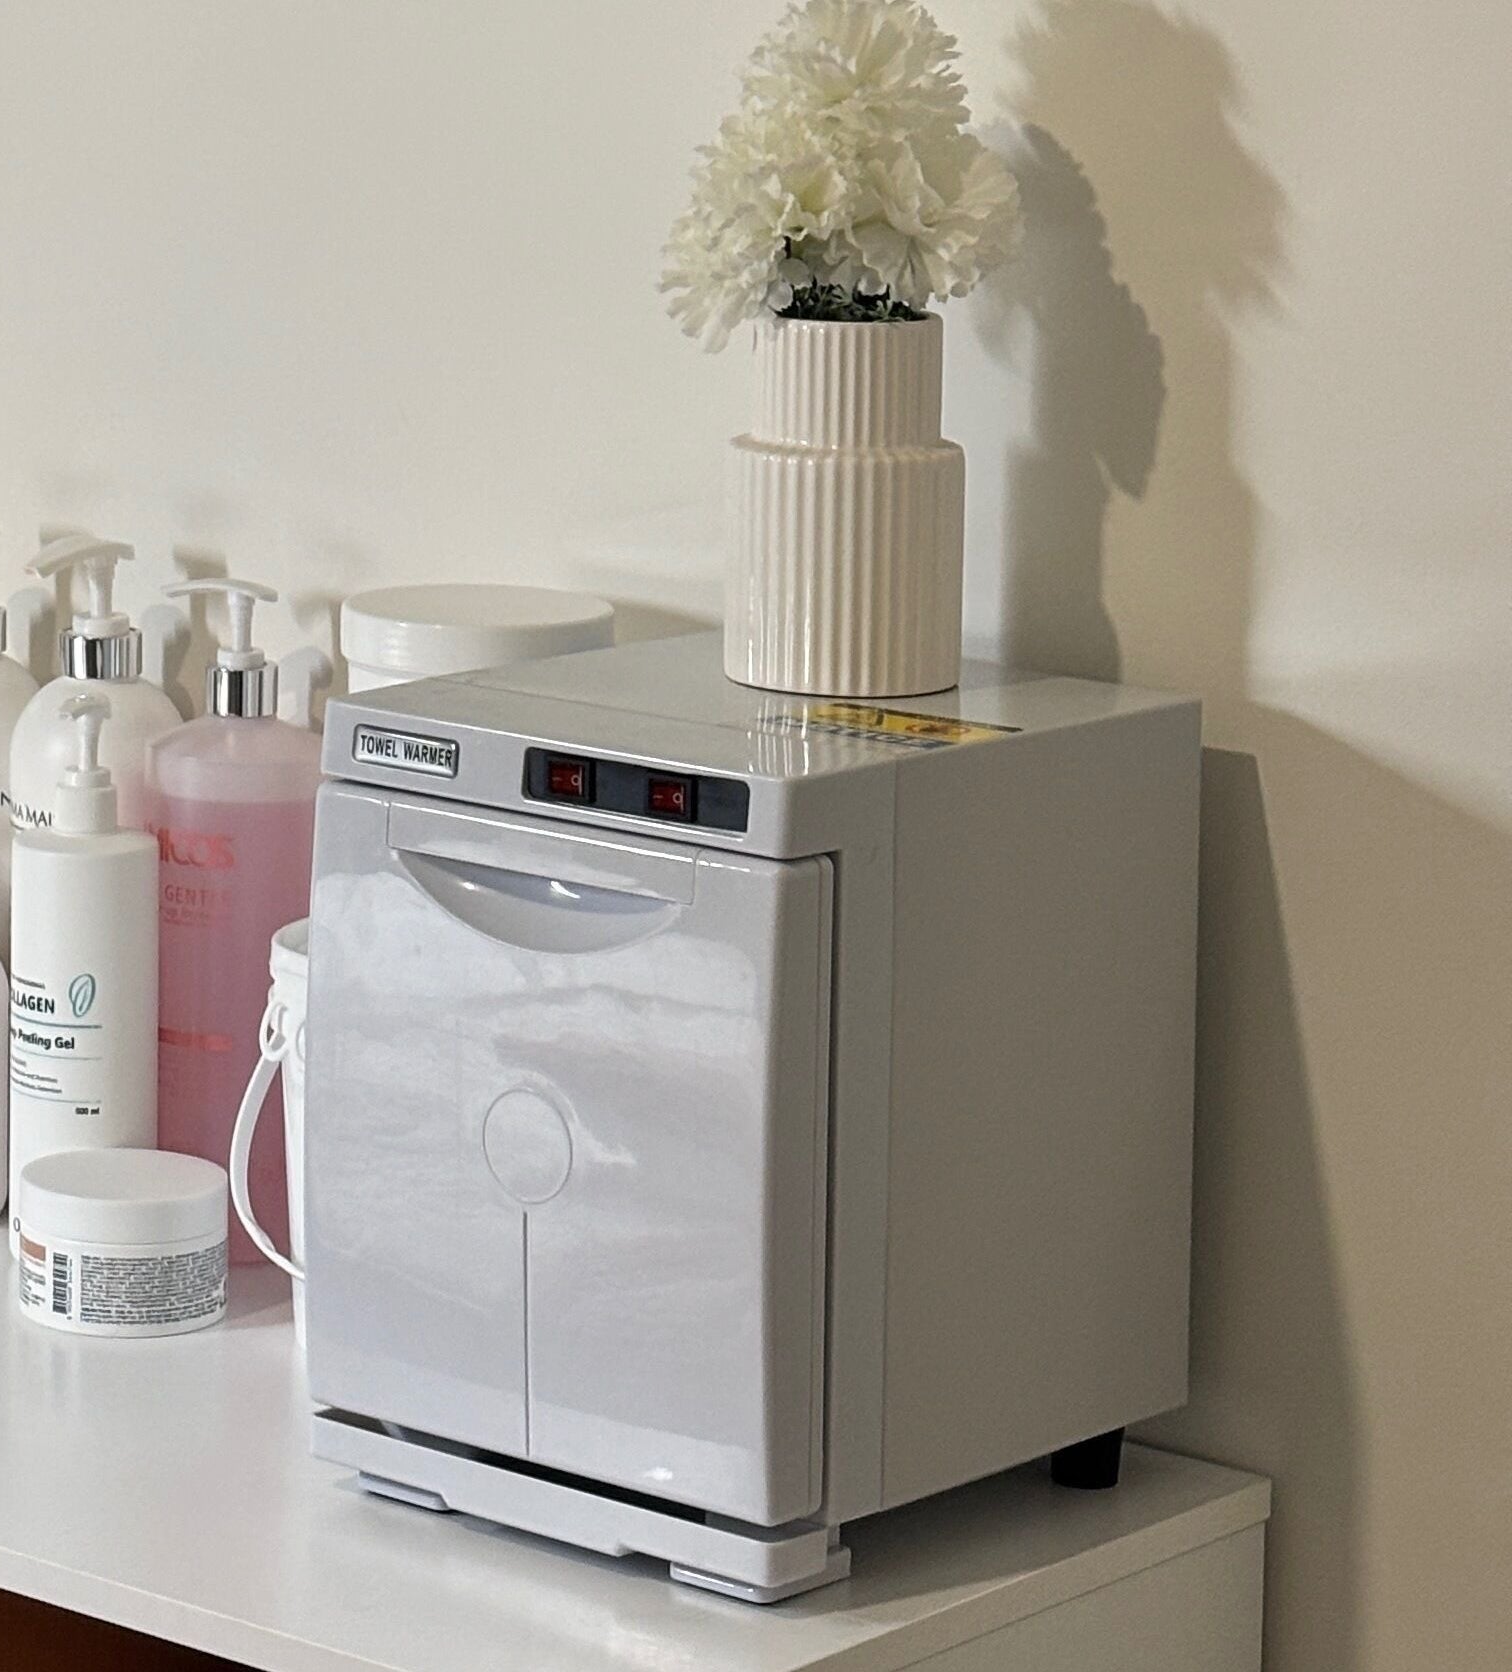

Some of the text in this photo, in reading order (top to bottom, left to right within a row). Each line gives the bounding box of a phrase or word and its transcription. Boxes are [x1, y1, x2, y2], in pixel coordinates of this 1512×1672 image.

[360, 734, 453, 768] TOWEL WARMER
[11, 989, 56, 1014] LLAGEN
[18, 1028, 51, 1050] Peeling
[54, 1036, 75, 1050] Gel
